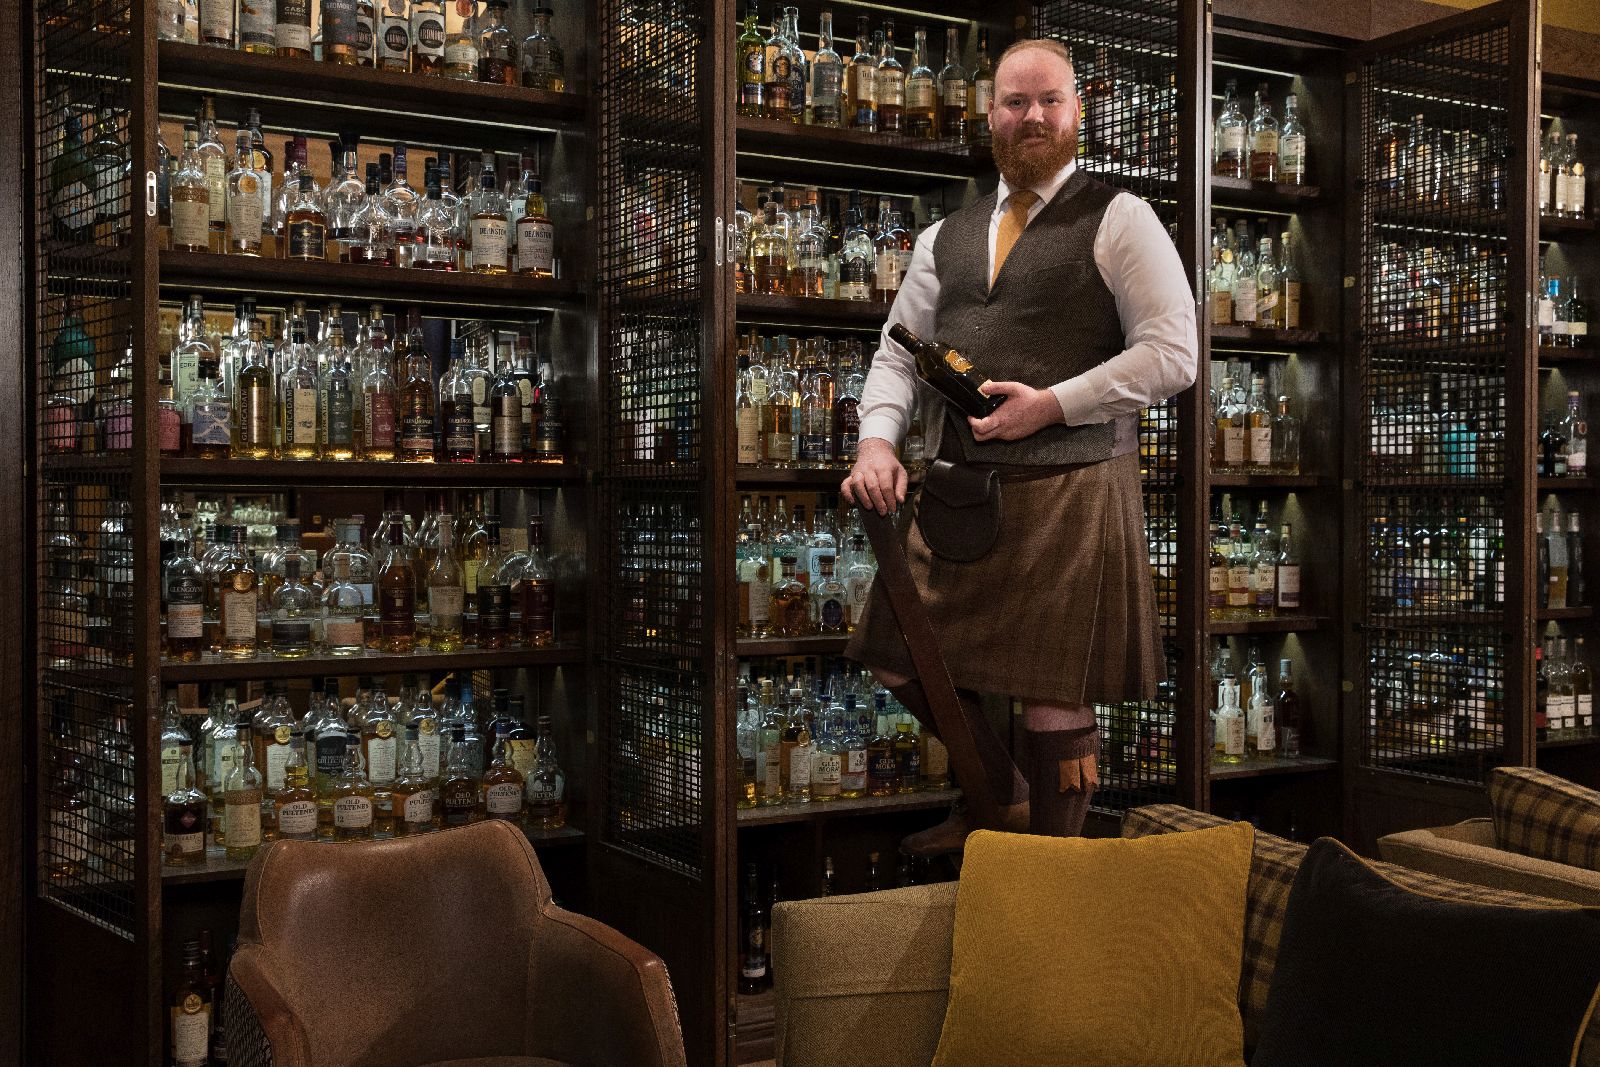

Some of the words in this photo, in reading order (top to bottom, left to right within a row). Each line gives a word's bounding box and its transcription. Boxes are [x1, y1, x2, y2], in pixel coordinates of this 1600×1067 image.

[364, 394, 372, 447] GLENCADAM
[282, 808, 317, 816] PULTENEY
[337, 815, 344, 823] 12
